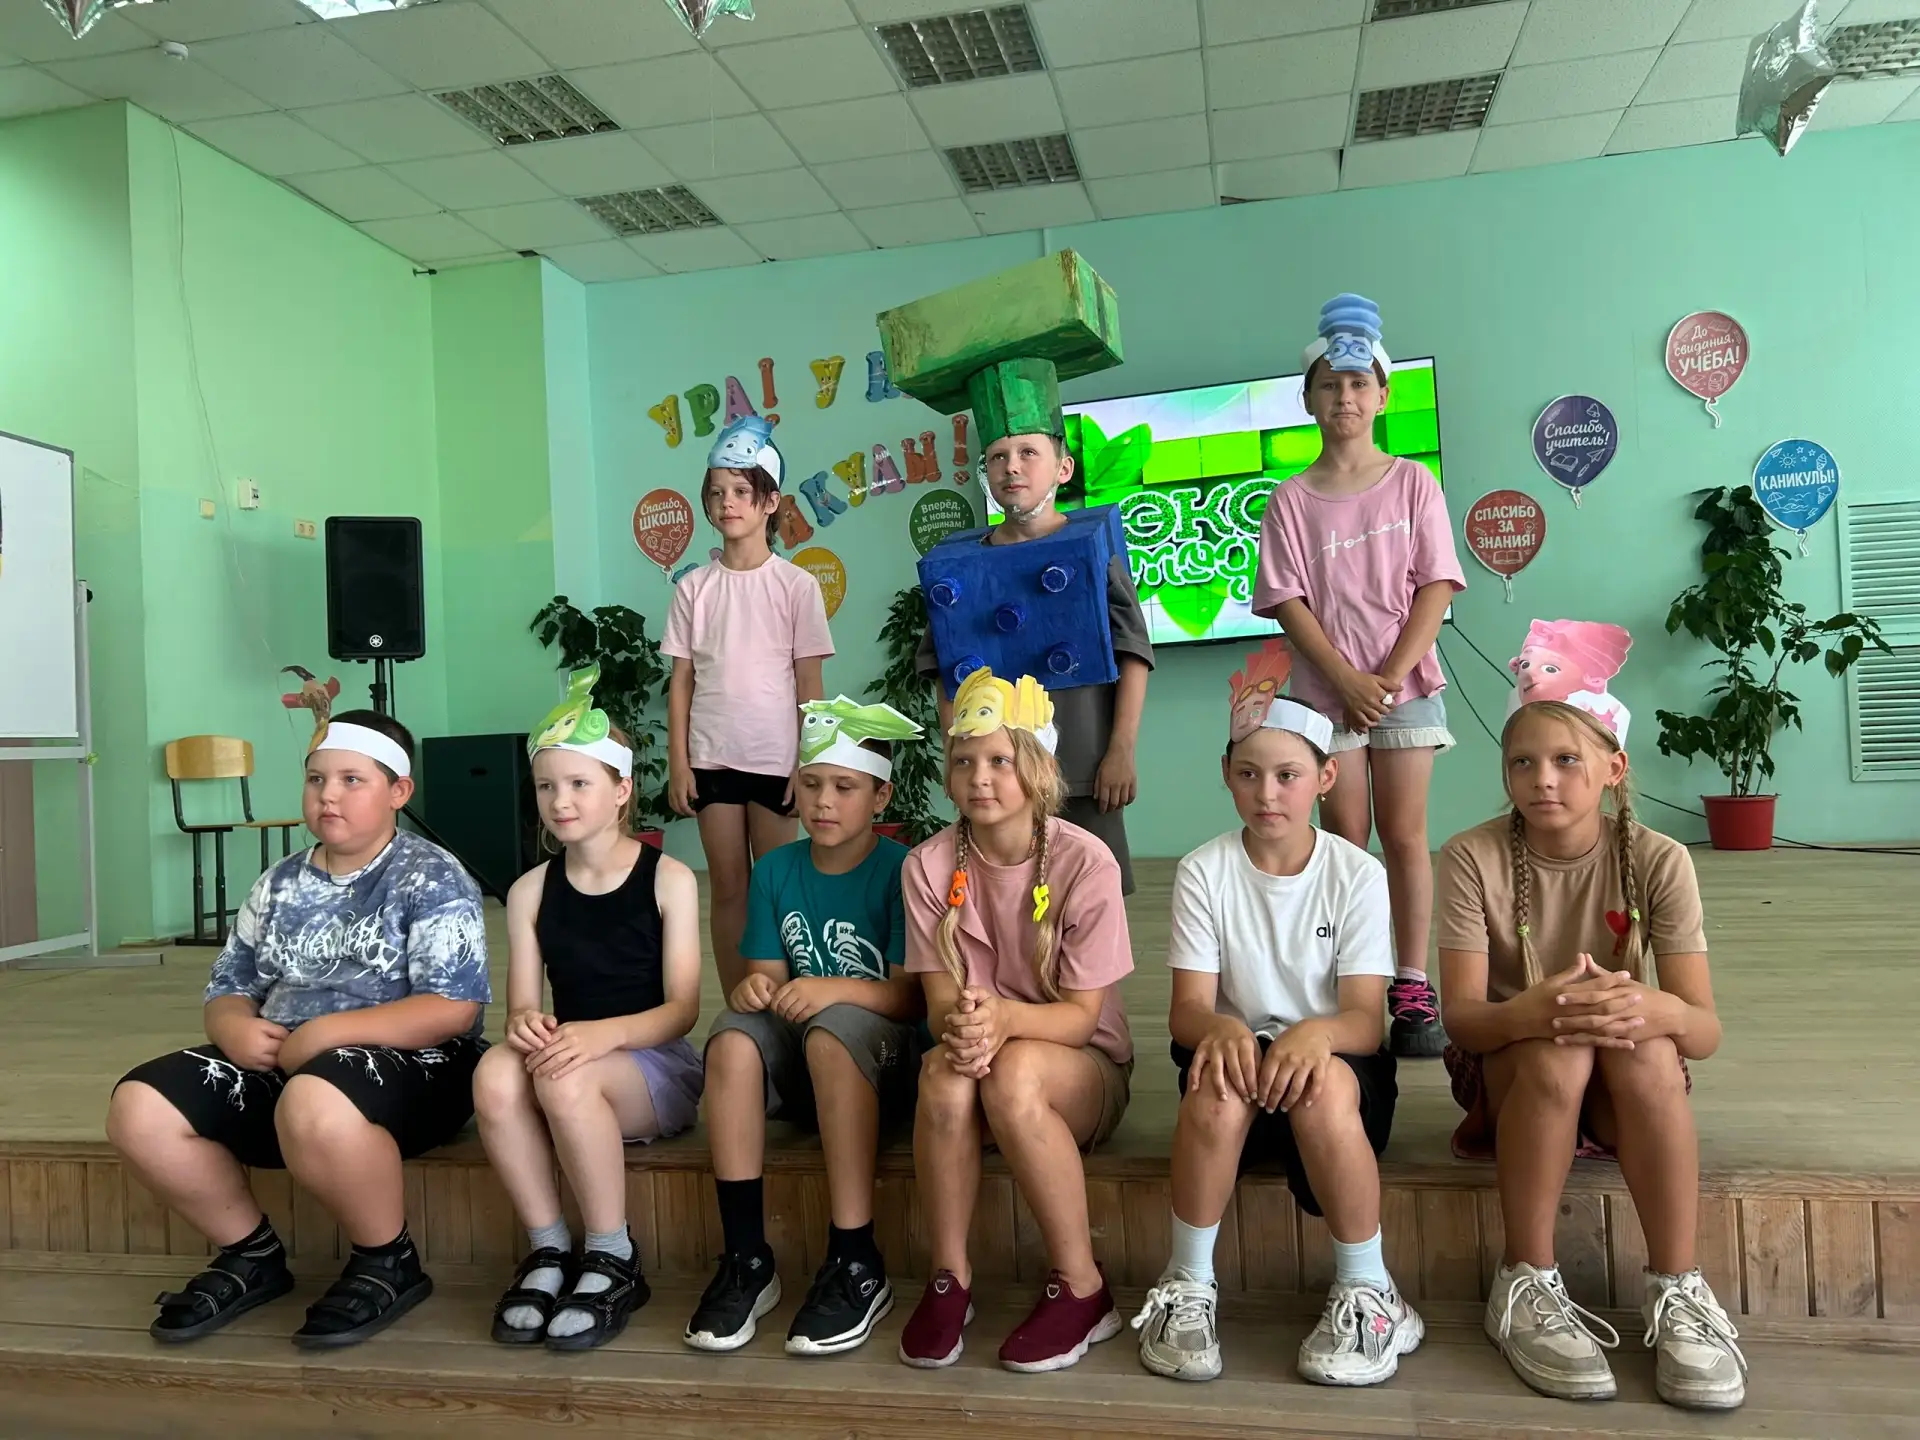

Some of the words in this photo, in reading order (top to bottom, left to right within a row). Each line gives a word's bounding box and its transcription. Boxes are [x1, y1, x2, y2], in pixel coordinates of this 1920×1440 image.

[1691, 325, 1708, 342] До
[1674, 334, 1735, 356] свидания,
[1679, 345, 1740, 376] УЧЁБА!
[648, 357, 781, 449] УРА!
[1544, 420, 1606, 439] Спасибо,
[1545, 432, 1610, 456] учитель!
[1760, 469, 1835, 491] КАНИКУЛЫ!
[640, 497, 683, 516] Спасибо,
[921, 499, 961, 514] Вперёд,
[1475, 505, 1536, 522] СПАСИБО
[640, 510, 688, 531] ШКОЛА!
[930, 512, 961, 521] новым
[917, 520, 966, 534] вершинам!
[1498, 520, 1515, 533] ЗА
[1476, 534, 1536, 549] ЗНАНИЯ!
